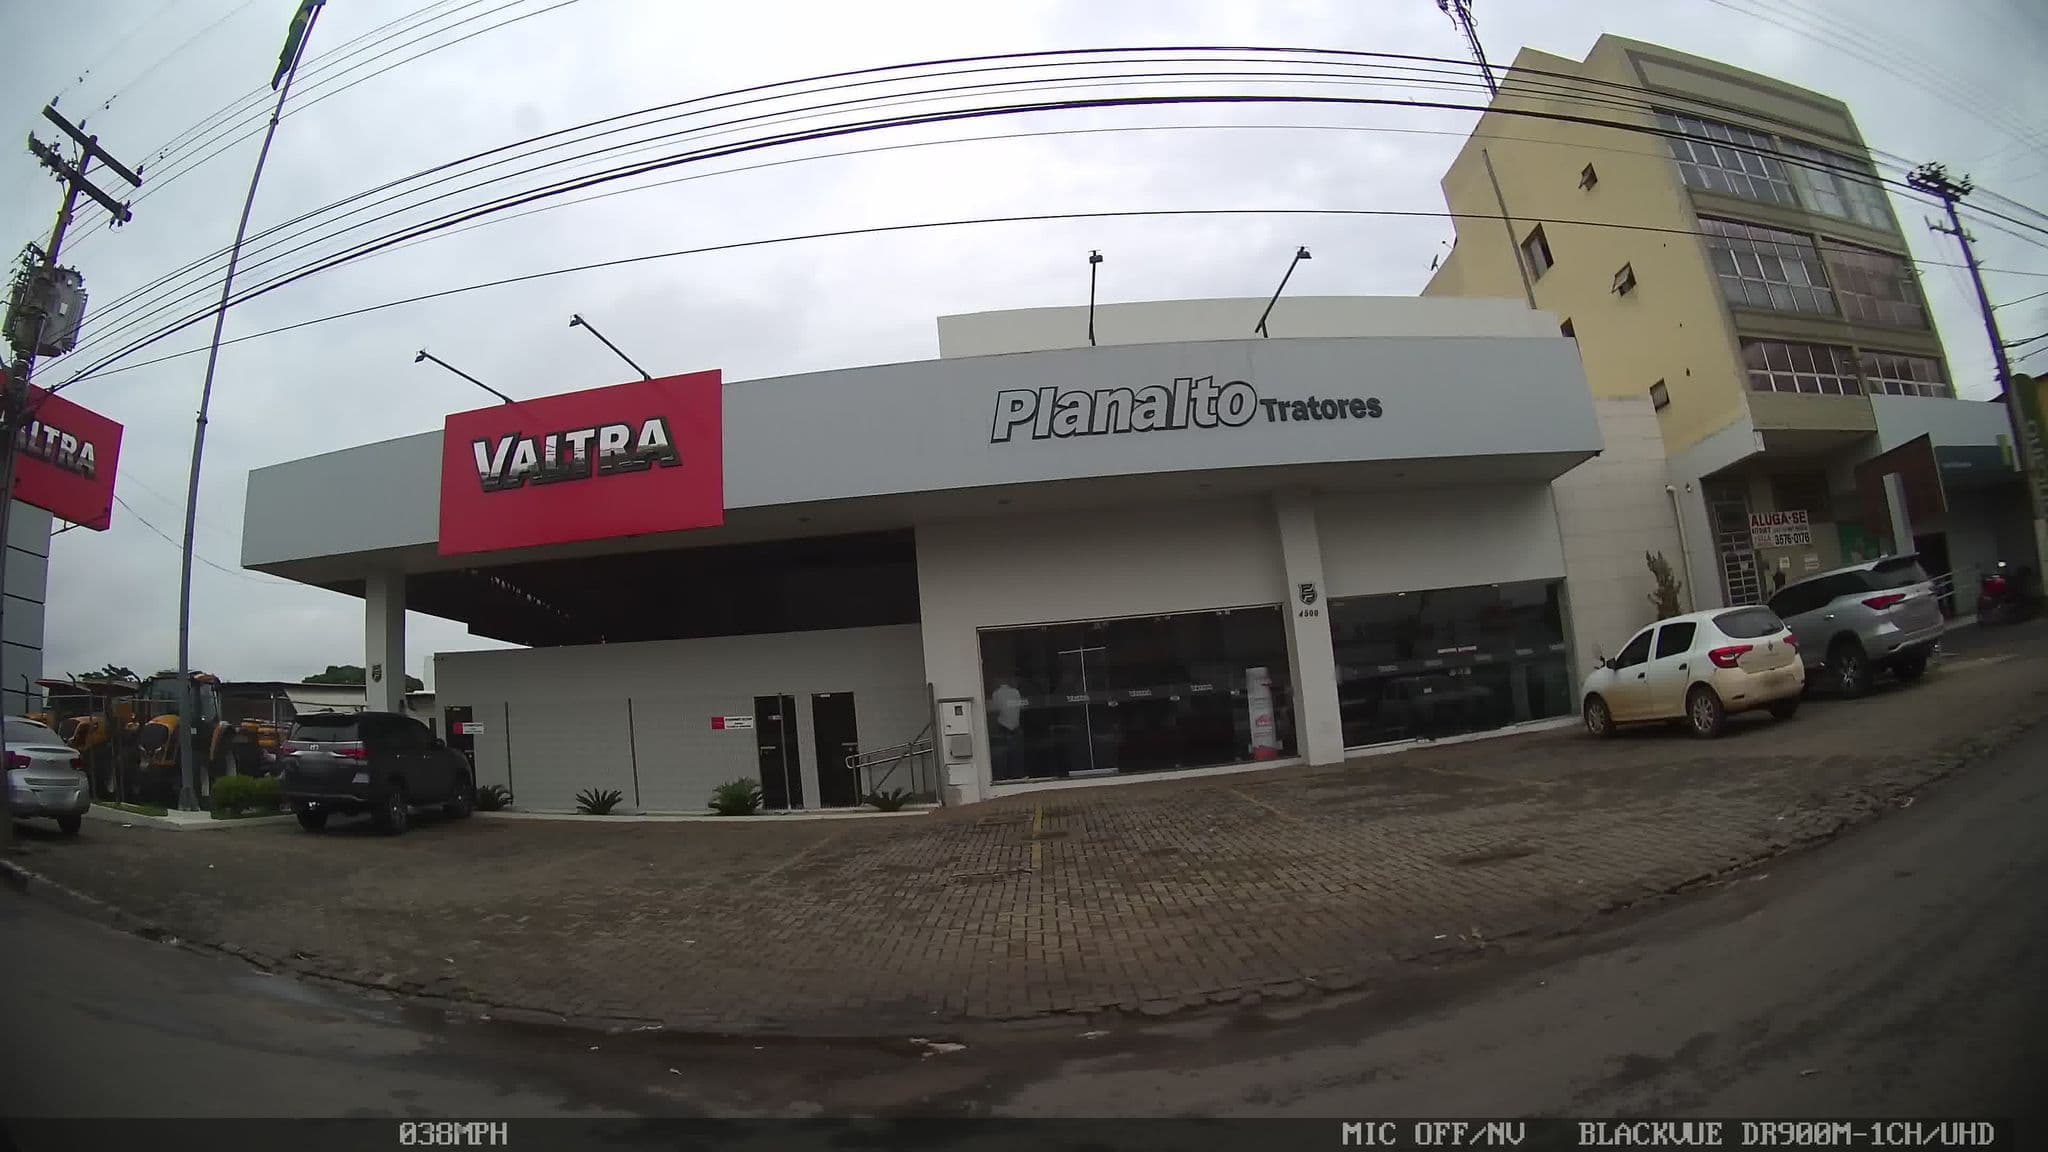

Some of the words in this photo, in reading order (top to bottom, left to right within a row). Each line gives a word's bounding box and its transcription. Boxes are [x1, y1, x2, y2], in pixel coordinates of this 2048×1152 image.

[990, 375, 1257, 443] Planalto
[1260, 395, 1383, 422] Tratores
[473, 416, 683, 492] VALTRA
[1751, 511, 1807, 527] ALUGA-SE
